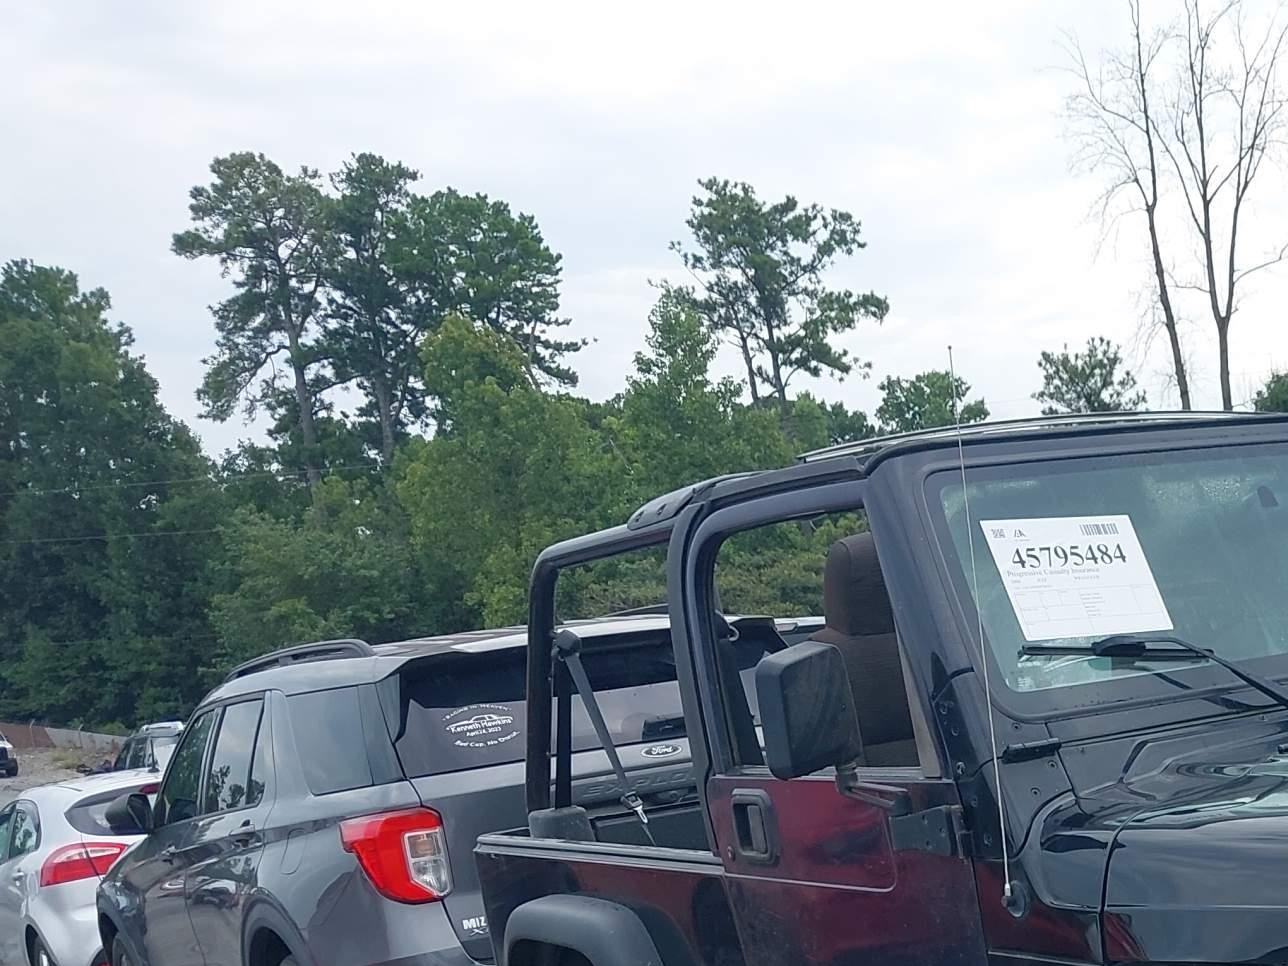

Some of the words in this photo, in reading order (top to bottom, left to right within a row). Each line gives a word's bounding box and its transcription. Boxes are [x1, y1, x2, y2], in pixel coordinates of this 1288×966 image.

[1011, 543, 1127, 569] 45795484
[450, 722, 481, 734] Kenneth
[651, 744, 674, 755] Ford
[582, 770, 697, 798] EXPLO
